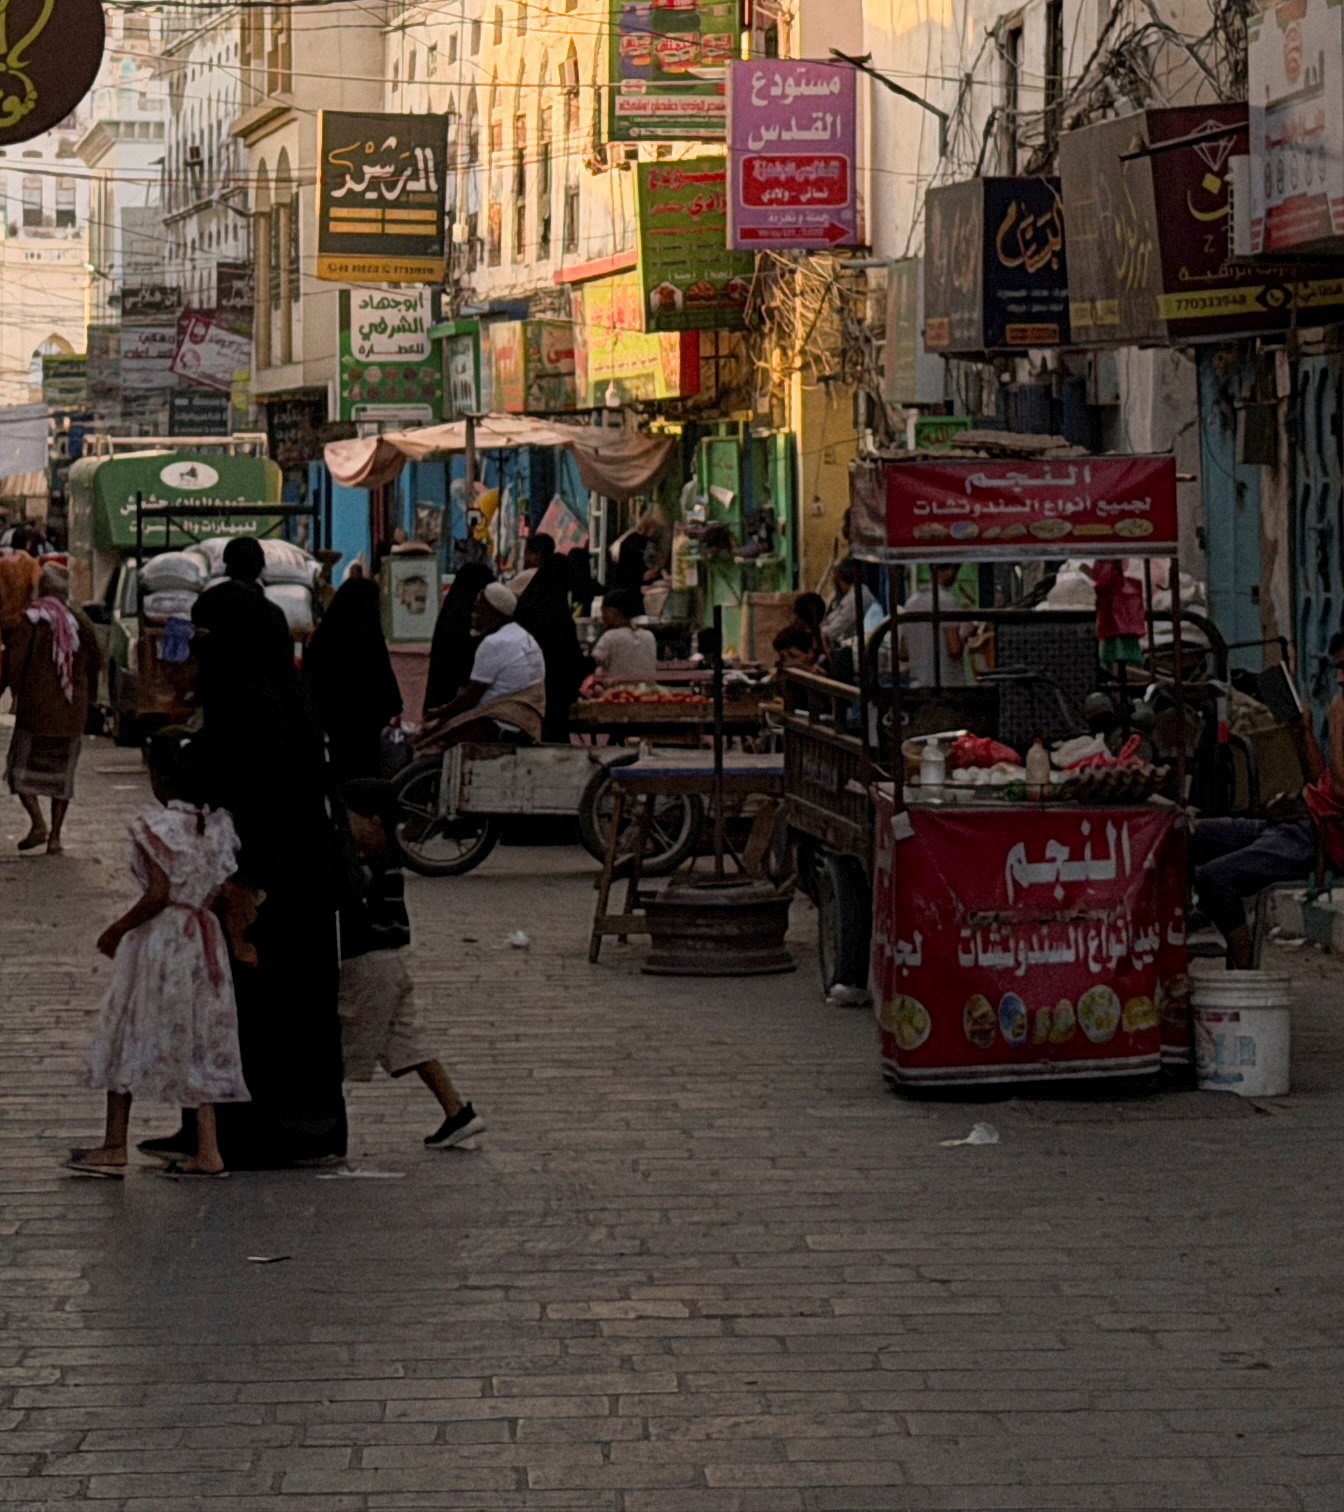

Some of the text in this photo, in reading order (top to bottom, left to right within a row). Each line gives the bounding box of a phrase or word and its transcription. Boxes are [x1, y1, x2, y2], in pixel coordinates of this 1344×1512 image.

[751, 67, 842, 107] مستودع
[747, 111, 842, 151] القدس
[965, 464, 1092, 496] النجم
[1096, 497, 1152, 516] لجميع
[1004, 818, 1132, 904] النجم
